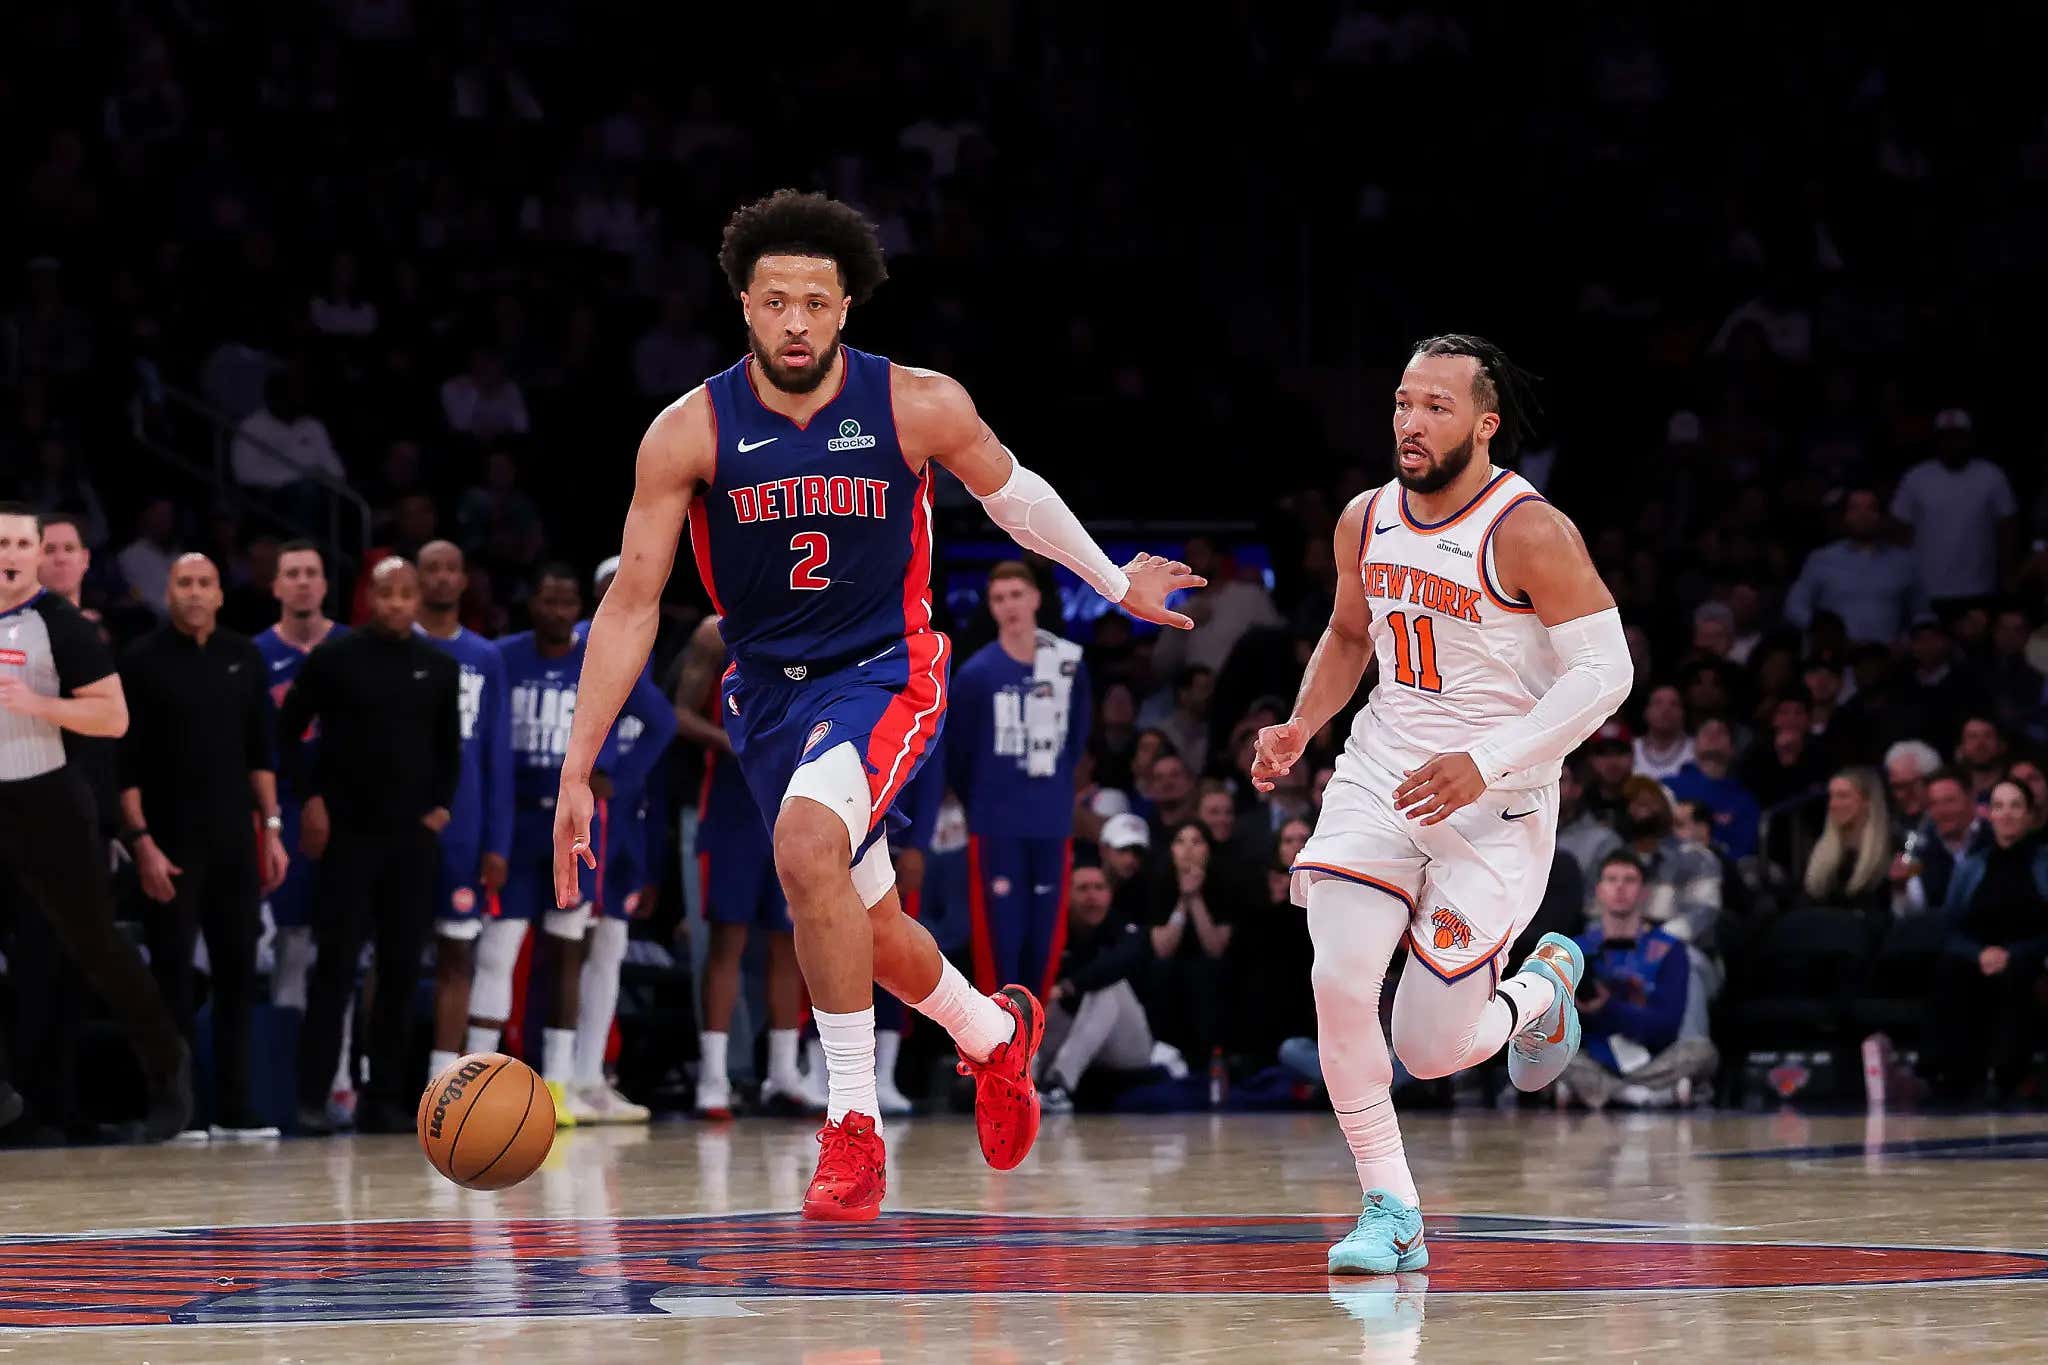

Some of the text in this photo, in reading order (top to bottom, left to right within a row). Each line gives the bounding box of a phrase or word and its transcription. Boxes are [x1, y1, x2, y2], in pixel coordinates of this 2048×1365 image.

[829, 437, 874, 450] StockX
[728, 475, 889, 523] DETROIT
[790, 531, 830, 590] 2
[1364, 562, 1482, 624] NEW YORK
[1386, 611, 1442, 693] 11
[429, 1061, 490, 1139] Wilson
